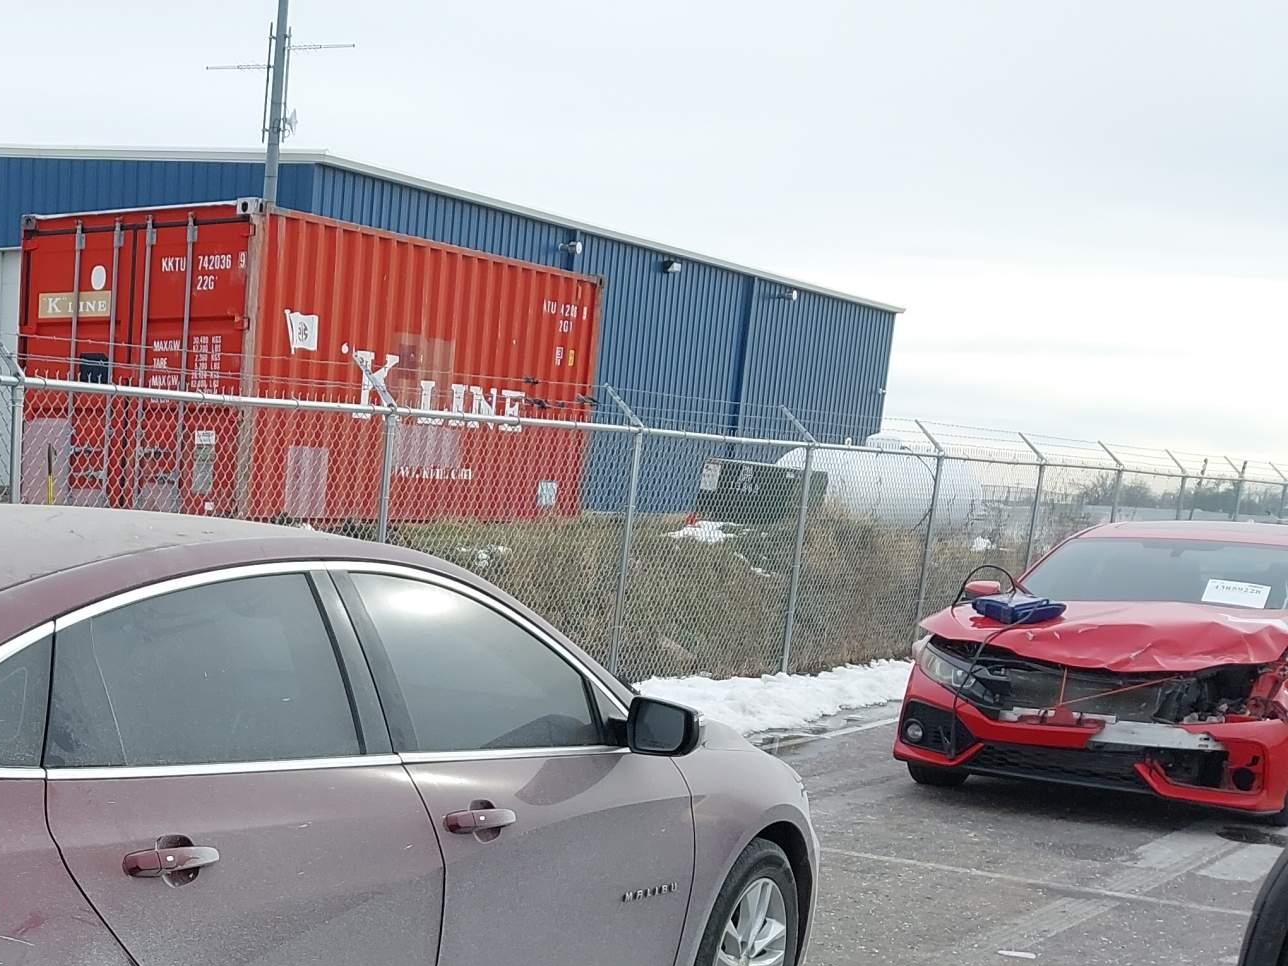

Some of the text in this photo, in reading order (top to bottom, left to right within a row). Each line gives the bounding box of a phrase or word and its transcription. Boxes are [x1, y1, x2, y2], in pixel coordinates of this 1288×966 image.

[161, 256, 187, 272] KKTU
[198, 254, 232, 271] 742036
[623, 882, 678, 902] MALIBU
